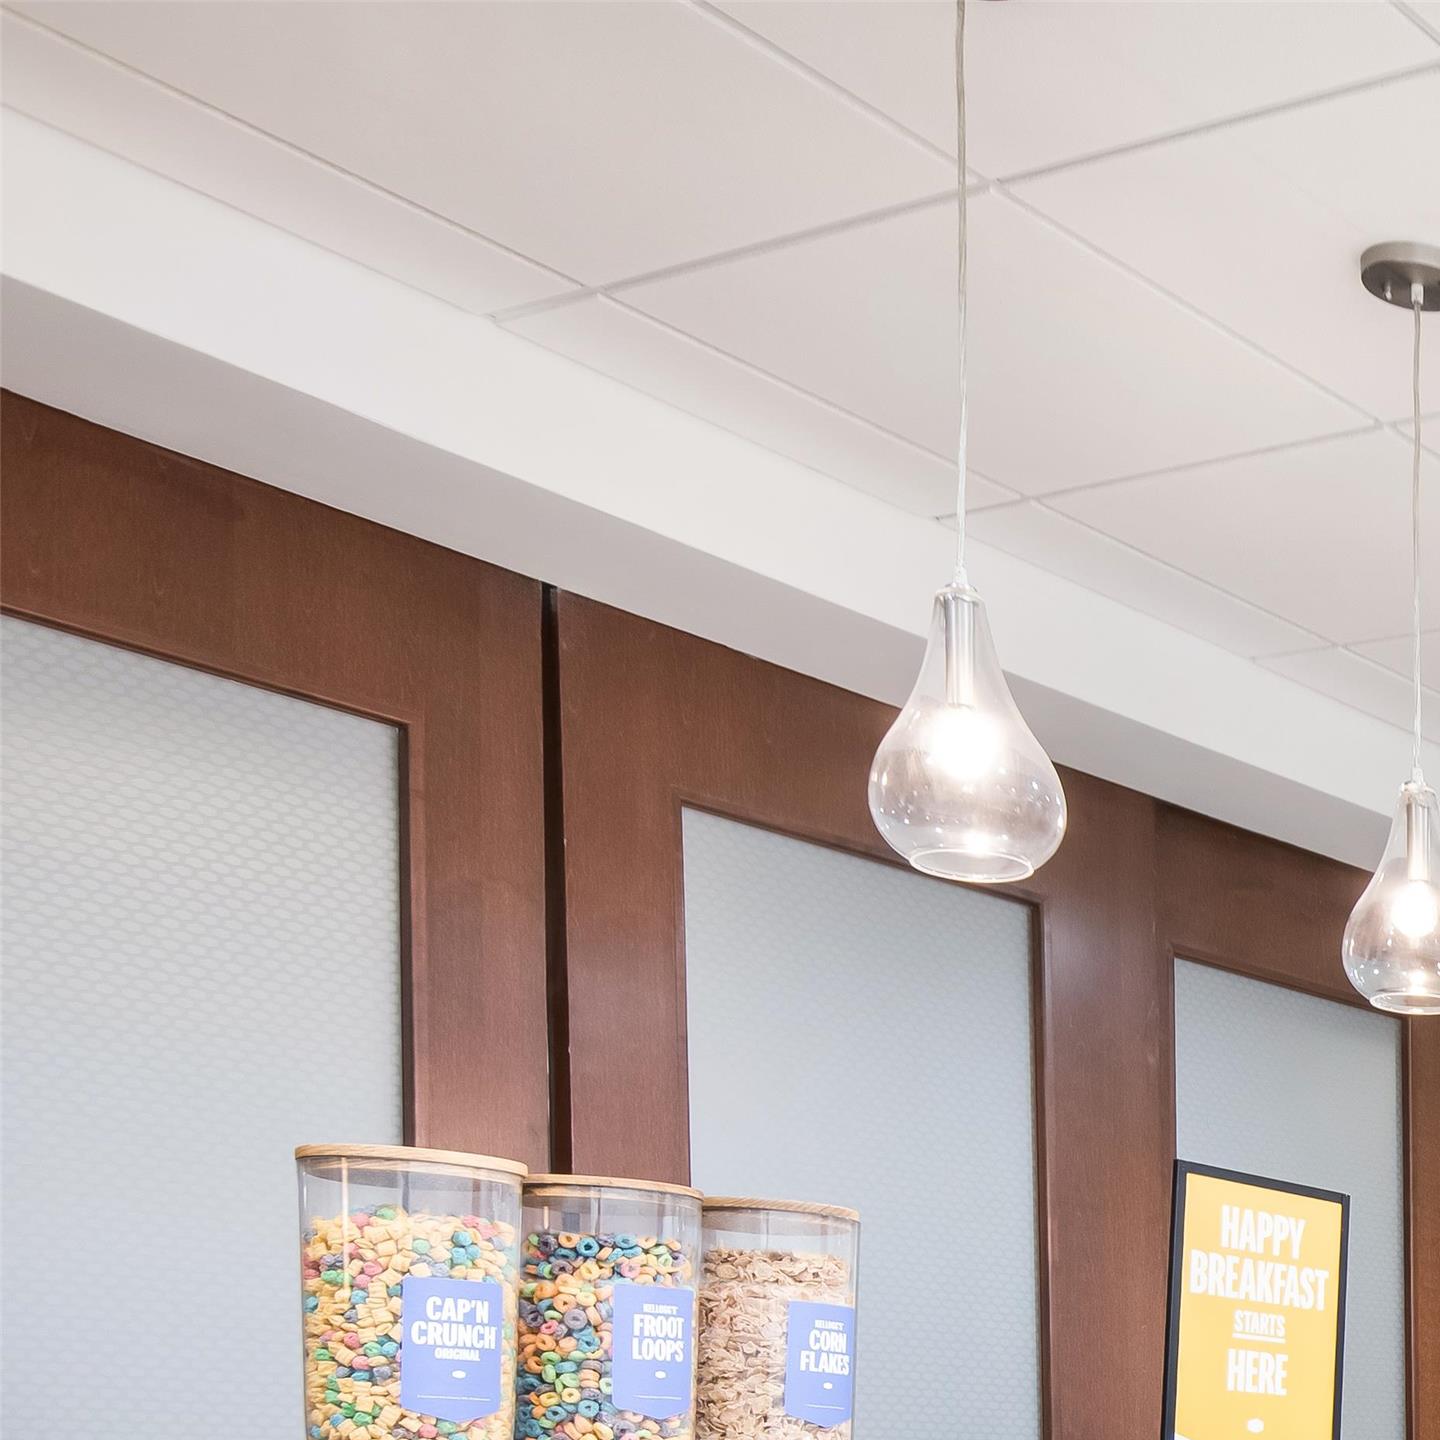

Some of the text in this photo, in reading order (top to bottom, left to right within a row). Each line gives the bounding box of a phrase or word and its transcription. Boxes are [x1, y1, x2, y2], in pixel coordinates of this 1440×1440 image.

[1221, 1205, 1305, 1259] HAPPY
[1189, 1249, 1329, 1311] BREAKFAST
[425, 1295, 490, 1324] CAP'N
[410, 1320, 498, 1350] CRUNCH
[632, 1313, 685, 1339] FROOT
[1233, 1310, 1285, 1337] STARTS
[434, 1347, 481, 1361] ORIGINAL
[632, 1337, 685, 1363] LOOPS
[808, 1329, 847, 1354] CORN
[799, 1350, 850, 1376] FLAKES
[1227, 1349, 1288, 1395] HERE
